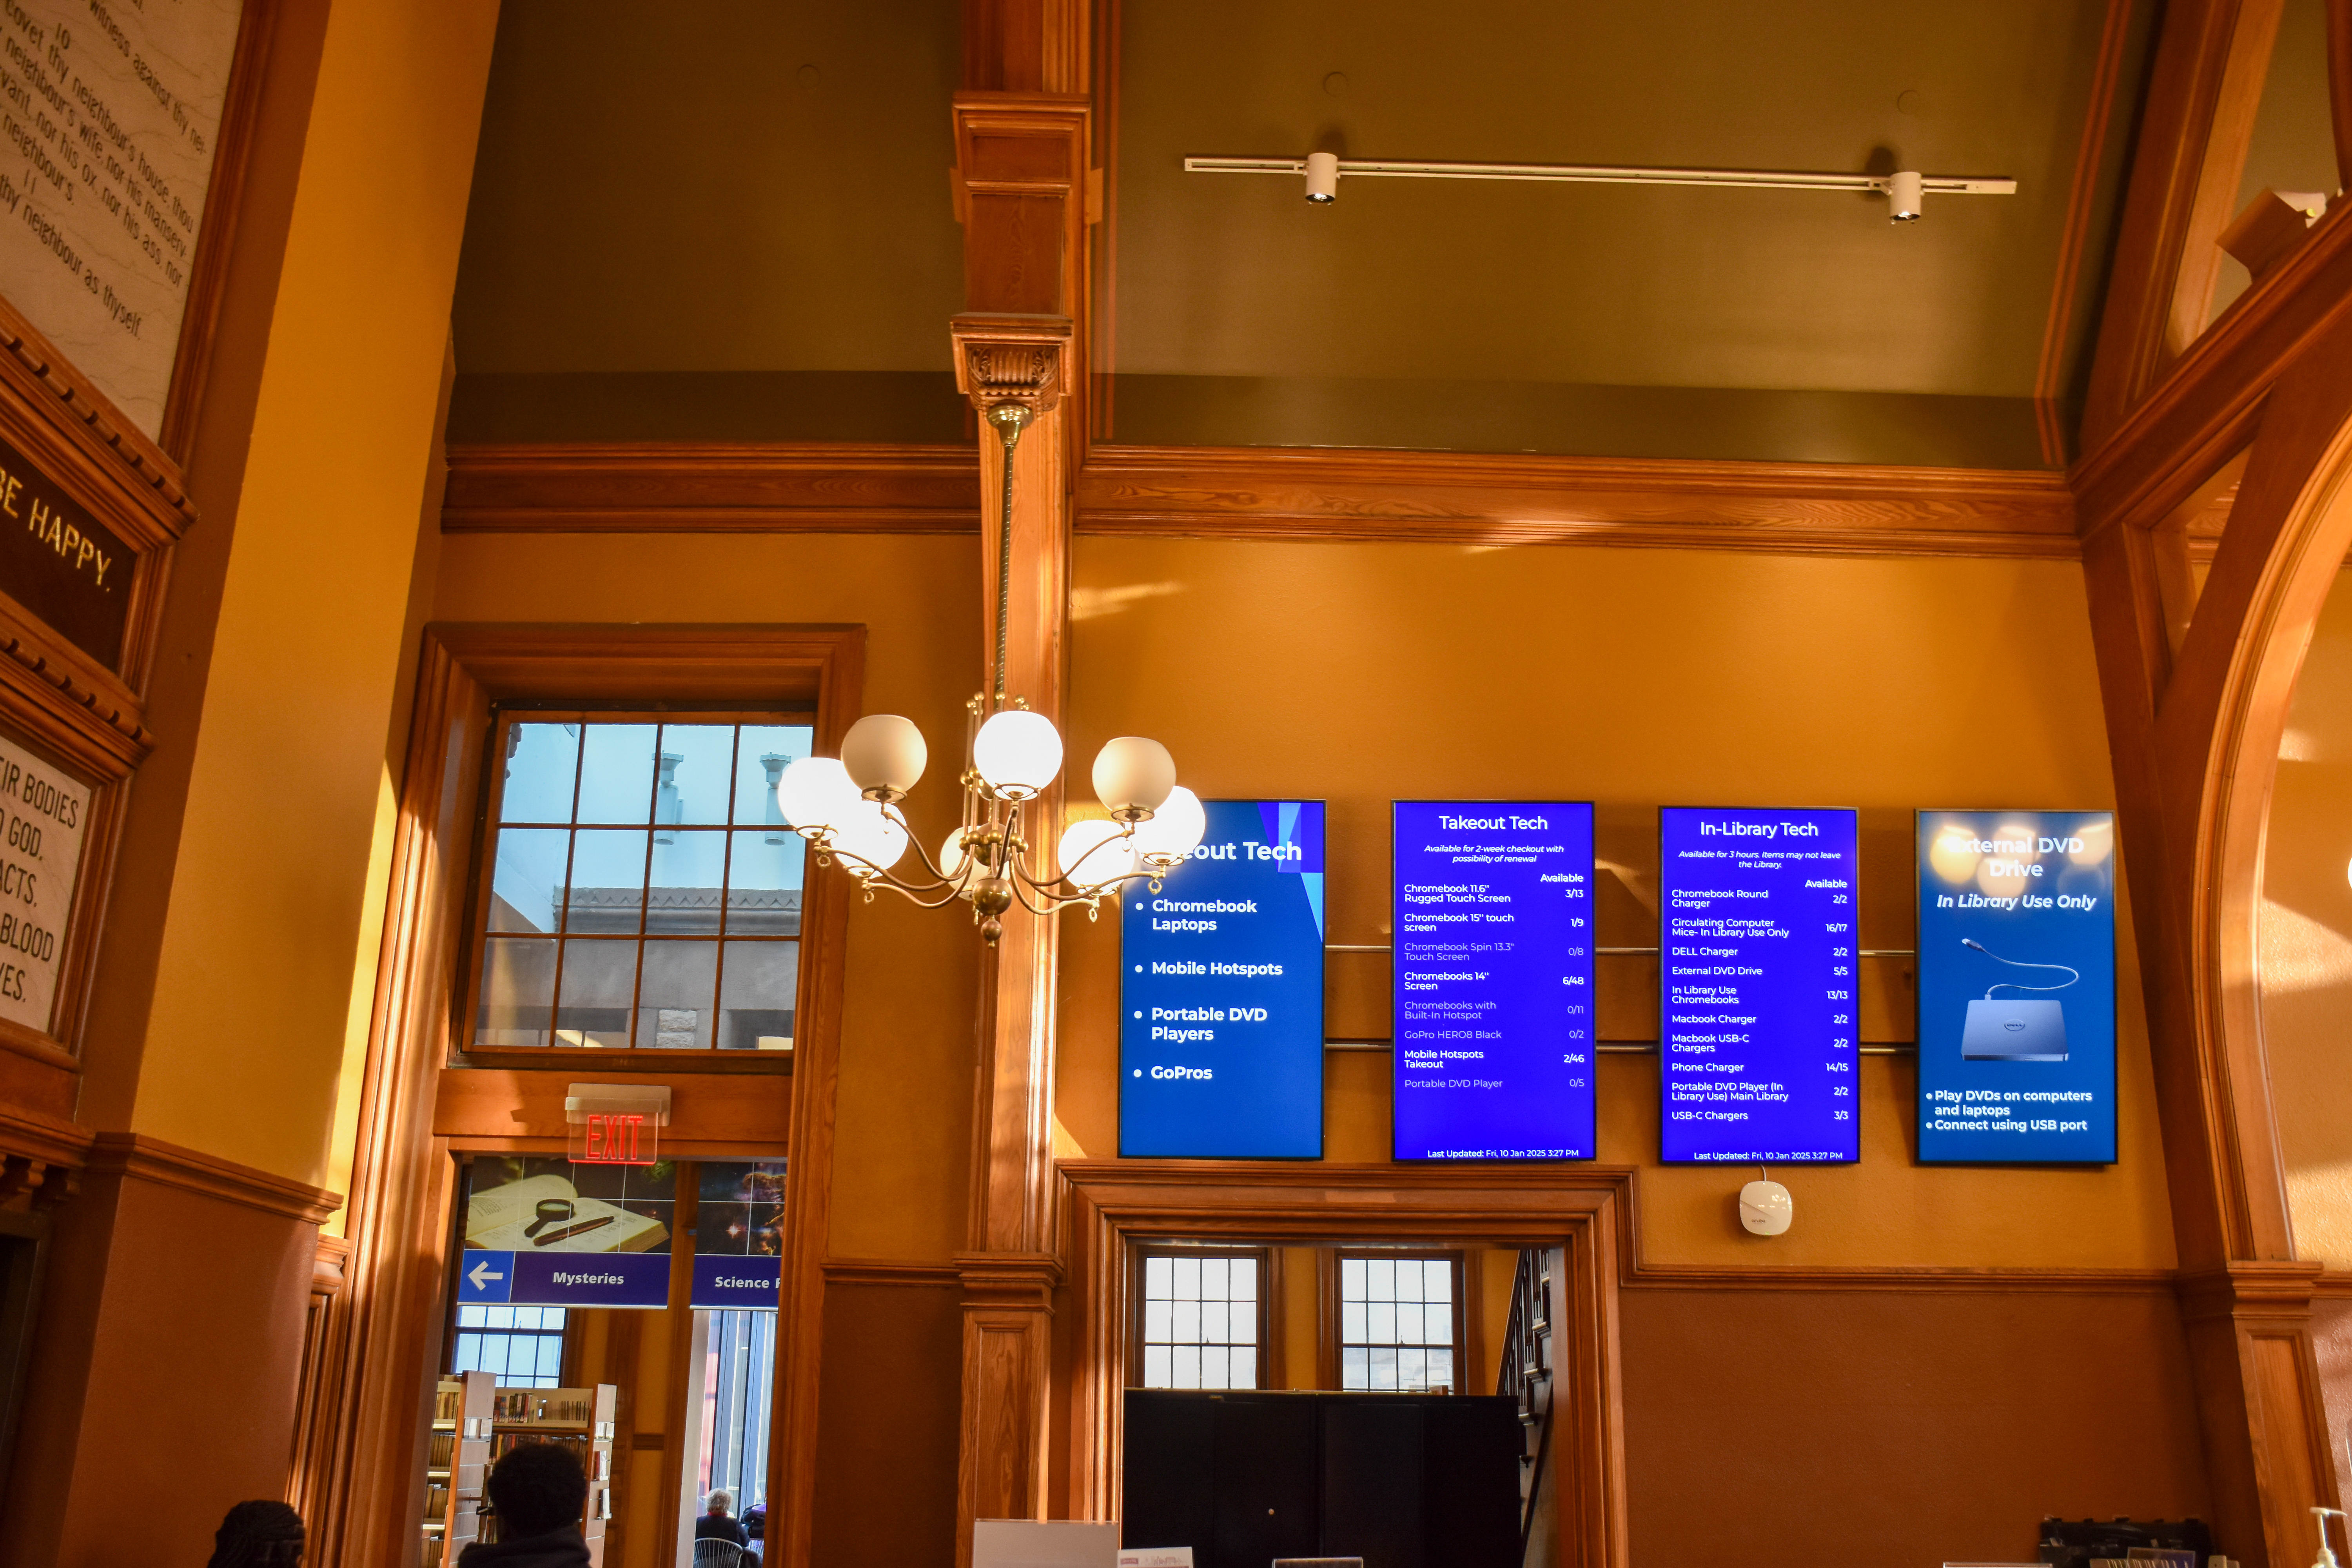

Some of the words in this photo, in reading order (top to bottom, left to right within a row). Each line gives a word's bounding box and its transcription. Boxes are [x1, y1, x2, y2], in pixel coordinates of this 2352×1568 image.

[55, 23, 70, 49] 10
[133, 53, 171, 111] against
[173, 101, 189, 136] thy
[6, 36, 76, 127] neighbour's
[106, 155, 128, 184] nor
[126, 173, 142, 207] his
[48, 44, 69, 84] thy
[73, 76, 136, 162] neighbour's
[172, 196, 193, 233] thou
[36, 110, 57, 143] nor
[60, 132, 78, 170] his
[102, 187, 122, 216] nor
[123, 205, 140, 240] his
[166, 260, 183, 288] nor
[23, 202, 82, 275] neighbour
[85, 269, 98, 295] as
[29, 497, 112, 592] HAPPY.
[23, 772, 78, 829] BODIES
[1438, 815, 1506, 829] Takeout
[1508, 815, 1548, 830] Tech
[1701, 821, 1778, 839] In-Library
[1780, 822, 1818, 836] Tech
[8, 816, 43, 861] GOD.
[1242, 841, 1302, 860] Tech
[1949, 837, 2032, 853] External
[2039, 838, 2084, 853] DVD
[1452, 855, 1493, 864] possibility
[1753, 860, 1782, 869] Library.
[1990, 859, 2043, 877] Drive
[1540, 873, 1584, 882] Available
[1404, 884, 1468, 893] Chromebook
[1804, 879, 1847, 888] Available
[1405, 893, 1443, 904] Rugged
[1445, 893, 1475, 902] Touch
[1477, 894, 1511, 902] Screen
[1565, 888, 1584, 898] 3/13
[1152, 899, 1258, 913] Chromebook
[1936, 895, 1953, 908] In
[1957, 893, 2018, 911] Library
[2022, 895, 2053, 908] Use
[2057, 894, 2097, 911] Only
[1404, 913, 1468, 922] Chromebook
[1485, 913, 1514, 922] touch
[1570, 917, 1584, 927] 1/9
[1671, 918, 1724, 928] Circulating
[1726, 918, 1775, 928] Computer
[1152, 918, 1217, 933] Laptops
[1825, 923, 1847, 933] 16/17
[0, 912, 54, 962] BLOOD
[1672, 927, 1699, 936] Mice-
[1700, 928, 1710, 936] In
[1712, 927, 1745, 938] Library
[1747, 927, 1765, 936] Use
[1767, 928, 1789, 938] Only
[1404, 942, 1468, 951] Chromebook
[1470, 942, 1492, 953] Spin
[1568, 946, 1584, 956] 0/8
[1672, 947, 1698, 956] DELL
[1699, 947, 1739, 957] Charger
[1833, 946, 1848, 957] 2/2
[1404, 952, 1434, 960] Touch
[1152, 961, 1207, 975] Mobile
[1210, 962, 1283, 978] Hotspots
[1672, 966, 1711, 975] External
[1713, 966, 1735, 975] DVD
[1738, 966, 1762, 975] Drive
[1833, 965, 1848, 976] 5/5
[1404, 971, 1473, 980] Chromebooks
[1563, 975, 1584, 986] 6/48
[1404, 982, 1438, 990] Screen
[1672, 985, 1682, 994] In
[1684, 985, 1717, 996] Library
[1719, 986, 1737, 994] Use
[1671, 995, 1739, 1004] Chromebooks
[1826, 990, 1848, 1000] 13/13
[1152, 1007, 1225, 1021] Portable
[1229, 1008, 1268, 1021] DVD
[1672, 1014, 1716, 1023] Macbook
[1718, 1014, 1757, 1025] Charger
[1833, 1014, 1848, 1024] 2/2
[1152, 1026, 1214, 1044] Players
[1404, 1031, 1435, 1039] GoPro
[1437, 1031, 1473, 1039] HERO8
[1475, 1030, 1502, 1038] Black
[1569, 1029, 1584, 1039] 0/2
[1405, 1049, 1438, 1058] Mobile
[1440, 1050, 1484, 1060] Hotspots
[1563, 1053, 1584, 1063] 2/46
[1404, 1060, 1444, 1068] Takeout
[1151, 1065, 1212, 1080] GoPros
[1935, 1090, 1963, 1103] Play
[1965, 1090, 2001, 1101] DVDs
[2003, 1092, 2020, 1101] on
[2023, 1091, 2092, 1103] computers
[1935, 1104, 1960, 1116] and
[1962, 1104, 2011, 1118] laptops
[1935, 1119, 1989, 1131] Connect
[1991, 1118, 2027, 1132] using
[2030, 1120, 2057, 1131] USB
[2060, 1120, 2087, 1132] port
[586, 1114, 643, 1160] EXIT
[1446, 1149, 1484, 1158] Updated:
[1486, 1149, 1498, 1158] Fri,
[553, 1272, 624, 1286] Mysteries
[715, 1276, 770, 1289] Science
